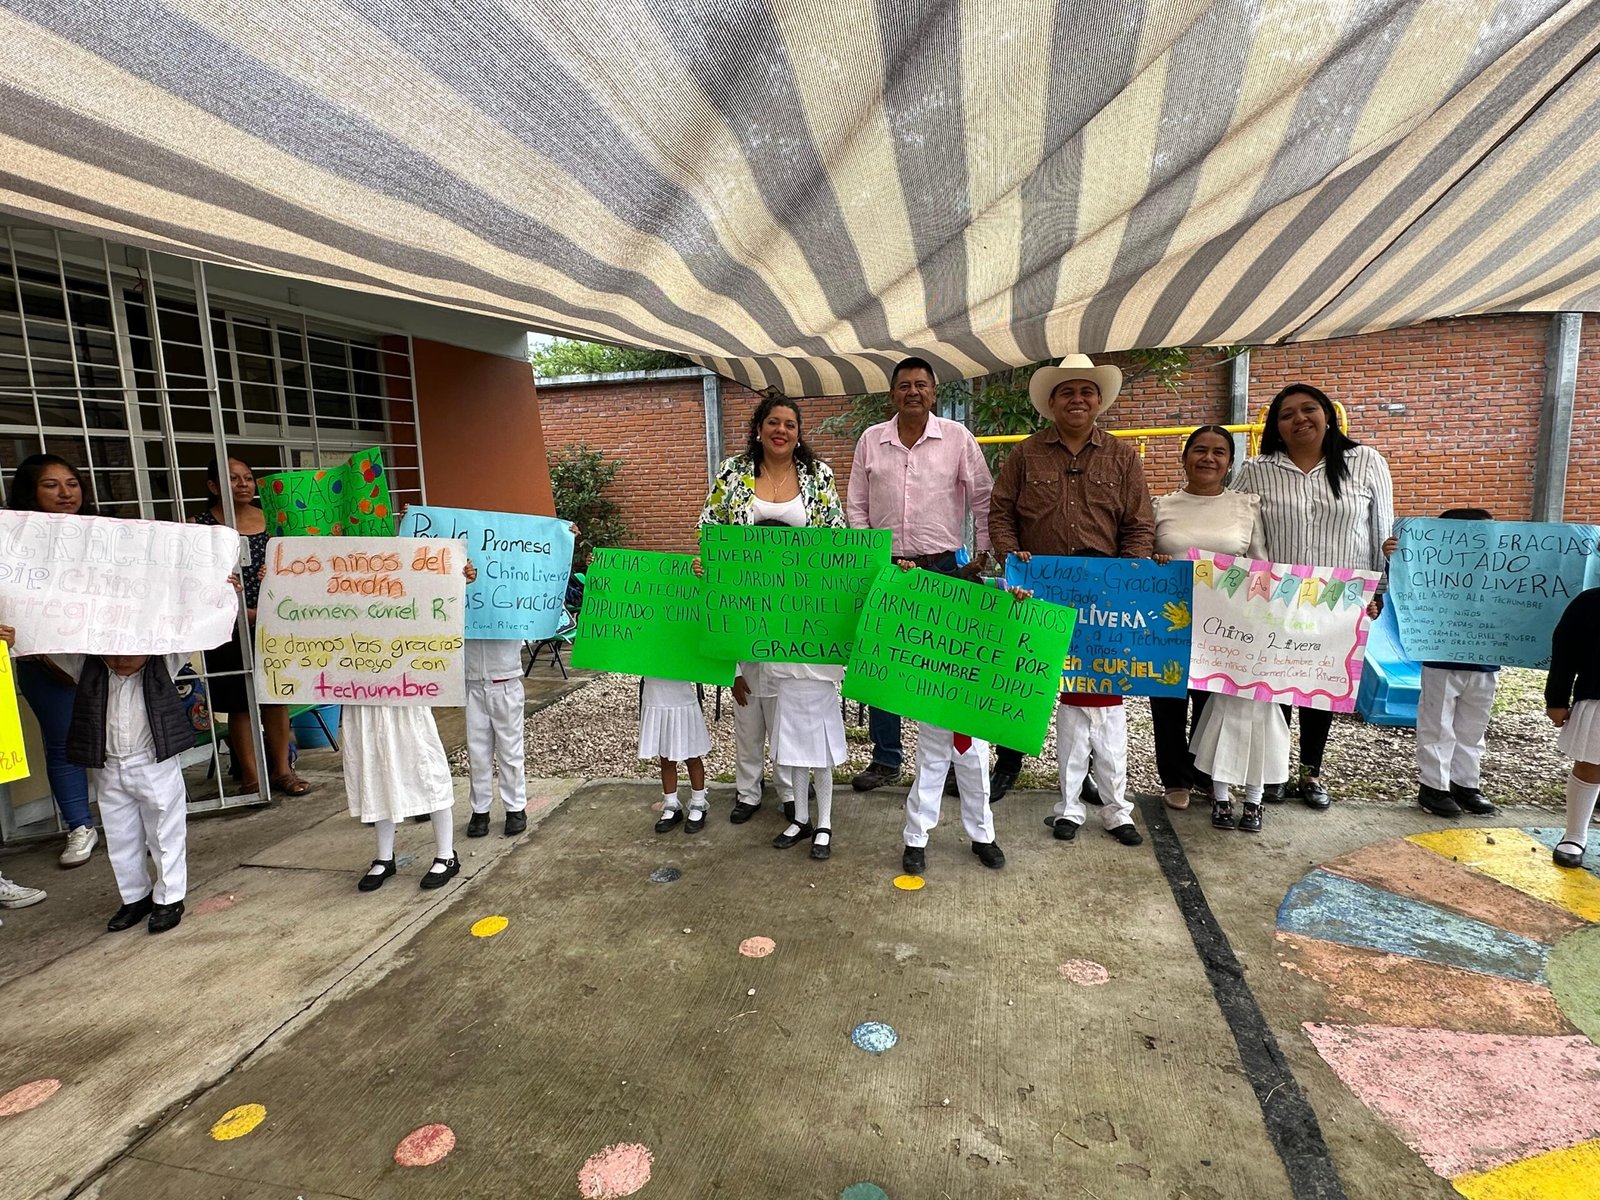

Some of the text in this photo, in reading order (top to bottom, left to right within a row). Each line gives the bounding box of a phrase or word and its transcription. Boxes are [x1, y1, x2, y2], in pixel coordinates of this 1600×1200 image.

[481, 529, 551, 555] Promesa
[706, 526, 728, 541] EL
[744, 527, 822, 547] DIPUTADO
[1399, 527, 1487, 549] MUCHAS
[276, 543, 446, 575] Los niños del
[593, 551, 650, 573] MUCHAS
[782, 551, 799, 566] SI
[808, 552, 874, 569] CUMPLE
[1400, 546, 1530, 572] DIPUTADO
[589, 576, 611, 592] POR
[624, 580, 641, 595] LA
[706, 567, 870, 595] EL JARDIN DE NIÑOS
[1412, 569, 1570, 598] CHINO LIVERA
[492, 584, 564, 612] Gracias
[585, 597, 654, 620] DIPUTADO
[705, 590, 771, 612] CARMEN
[780, 593, 847, 614] CURIEL
[879, 566, 1068, 633] EL JARDIN DE NIÑOS
[1397, 592, 1413, 601] POR
[1419, 592, 1427, 600] EL
[1431, 591, 1460, 601] APOYO
[1491, 596, 1543, 610] TECHUMBRE
[707, 613, 829, 637] LE DA LAS
[869, 588, 941, 625] CARMEN
[946, 611, 1008, 646] CURIEL
[1447, 620, 1473, 629] PAPAS
[1454, 609, 1481, 617] NIÑOS
[261, 626, 463, 658] le damos las gracias
[1093, 631, 1101, 641] a
[1203, 616, 1254, 644] Chino
[1427, 628, 1460, 637] CARMEN
[1467, 631, 1495, 639] CURIEL
[1503, 632, 1537, 643] RIVERA
[1451, 638, 1487, 646] GRACIAS
[864, 613, 1050, 680] LE AGRADECE POR
[1086, 645, 1117, 657] niños
[1197, 639, 1207, 650] el
[1209, 645, 1240, 659] apoyo
[1258, 649, 1268, 663] la
[1274, 653, 1314, 667] techumbre
[1318, 655, 1336, 668] del
[263, 657, 291, 676] por
[340, 657, 392, 674] apoyo
[411, 658, 446, 671] con
[858, 638, 1045, 698] LA TECHUMBRE DIPU-
[1211, 657, 1222, 668] de
[1225, 661, 1247, 673] niños
[1252, 662, 1286, 679] Carmen
[1287, 666, 1311, 679] Curiel
[1315, 667, 1347, 684] Rivera
[273, 671, 439, 699] la techumbre
[853, 658, 888, 681] TADO
[964, 690, 1025, 721] LIVERA
